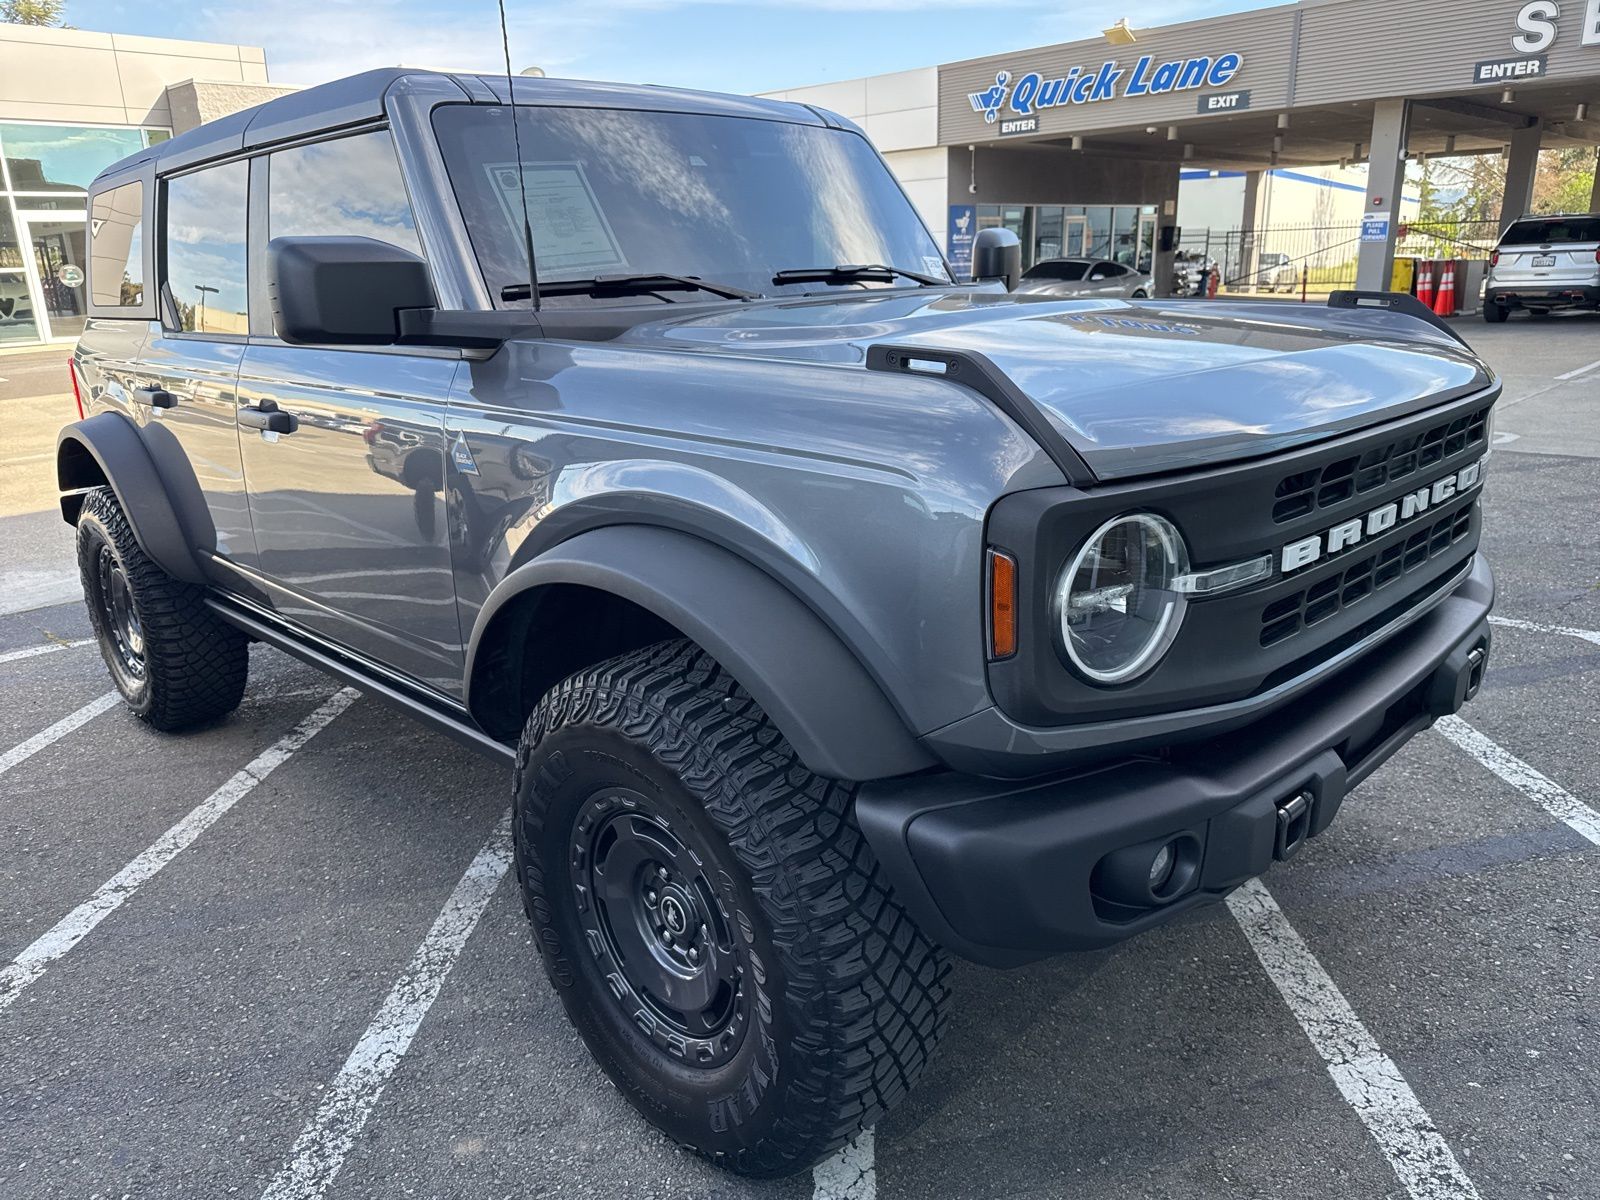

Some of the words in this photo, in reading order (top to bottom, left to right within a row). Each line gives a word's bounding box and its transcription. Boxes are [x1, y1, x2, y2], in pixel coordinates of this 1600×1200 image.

[1480, 60, 1540, 79] ENTER
[1010, 61, 1125, 115] Quick
[1123, 53, 1243, 97] Lane
[1208, 94, 1240, 109] EXIT
[1001, 119, 1036, 133] ENTER
[1281, 462, 1479, 572] BRONCO
